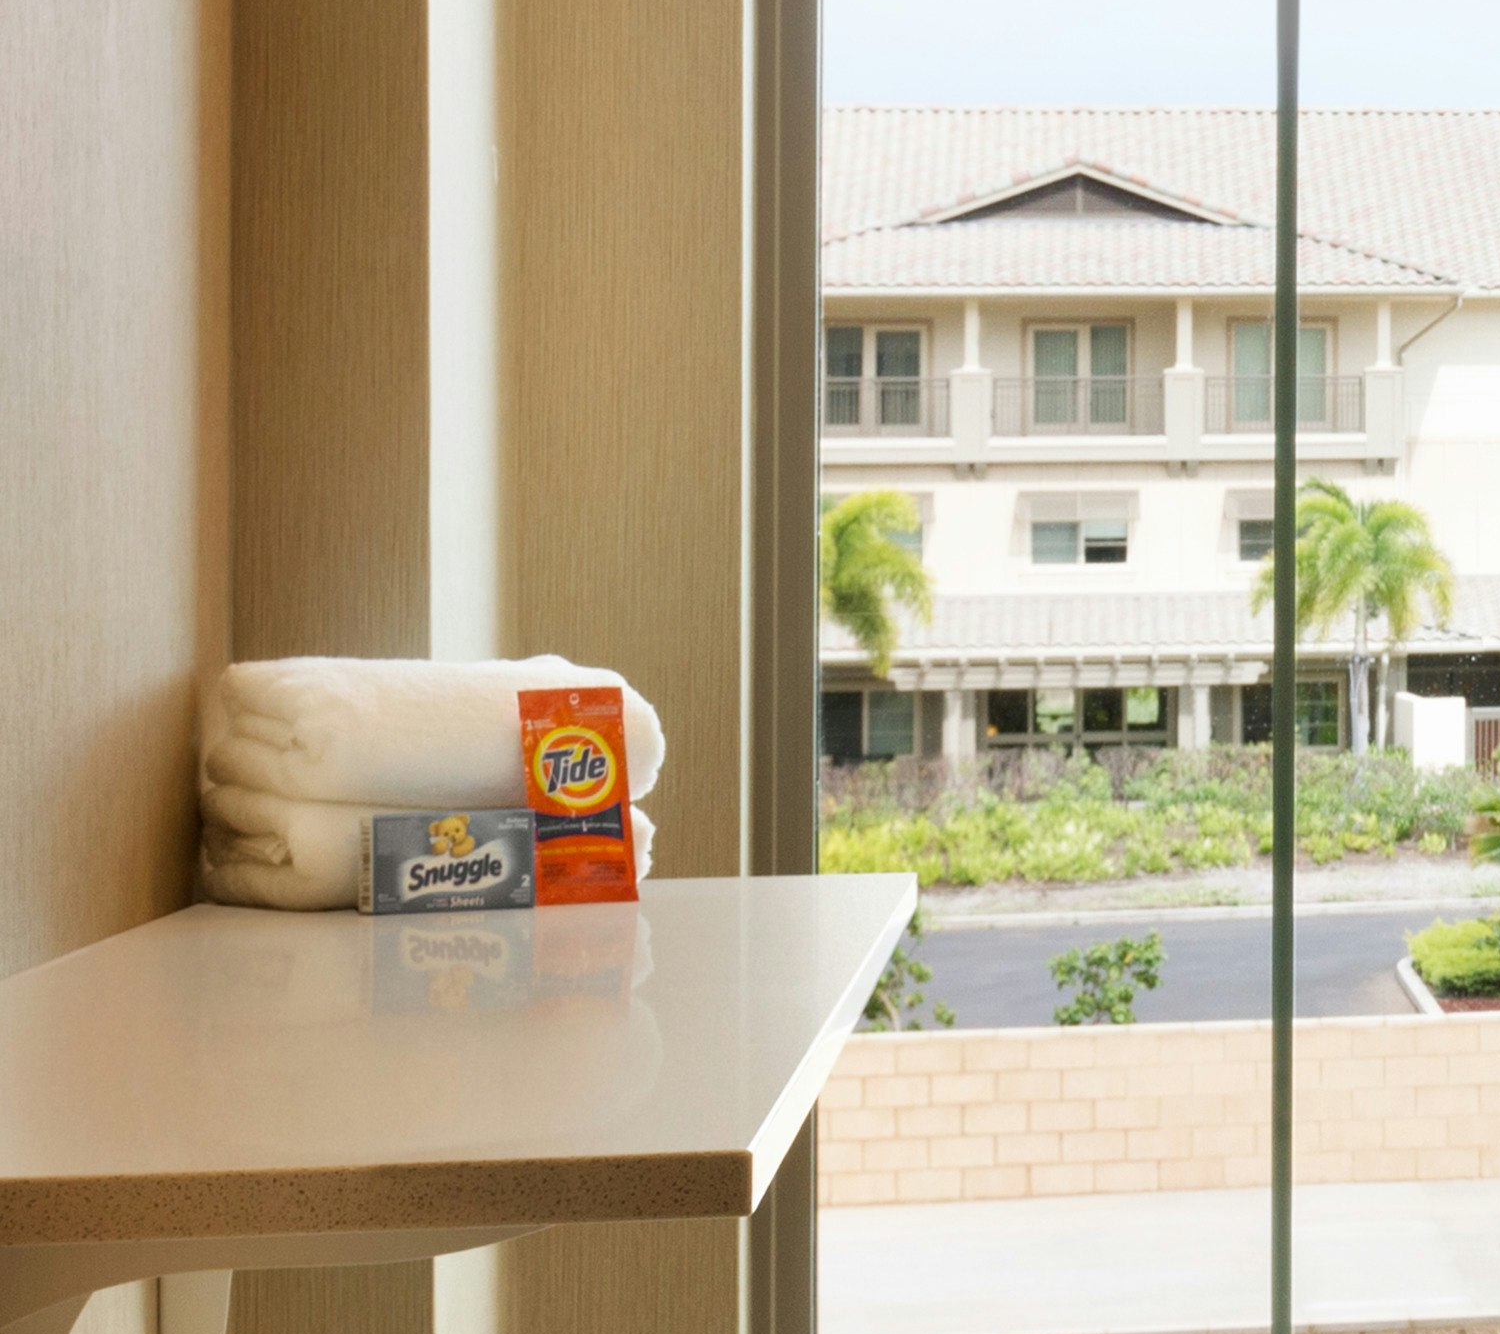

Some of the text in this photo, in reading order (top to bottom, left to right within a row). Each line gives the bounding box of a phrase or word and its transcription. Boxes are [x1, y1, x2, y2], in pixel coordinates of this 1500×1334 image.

[541, 746, 607, 795] Tide
[408, 853, 503, 892] Snuggle
[521, 875, 531, 887] 2
[450, 895, 485, 908] Sheets
